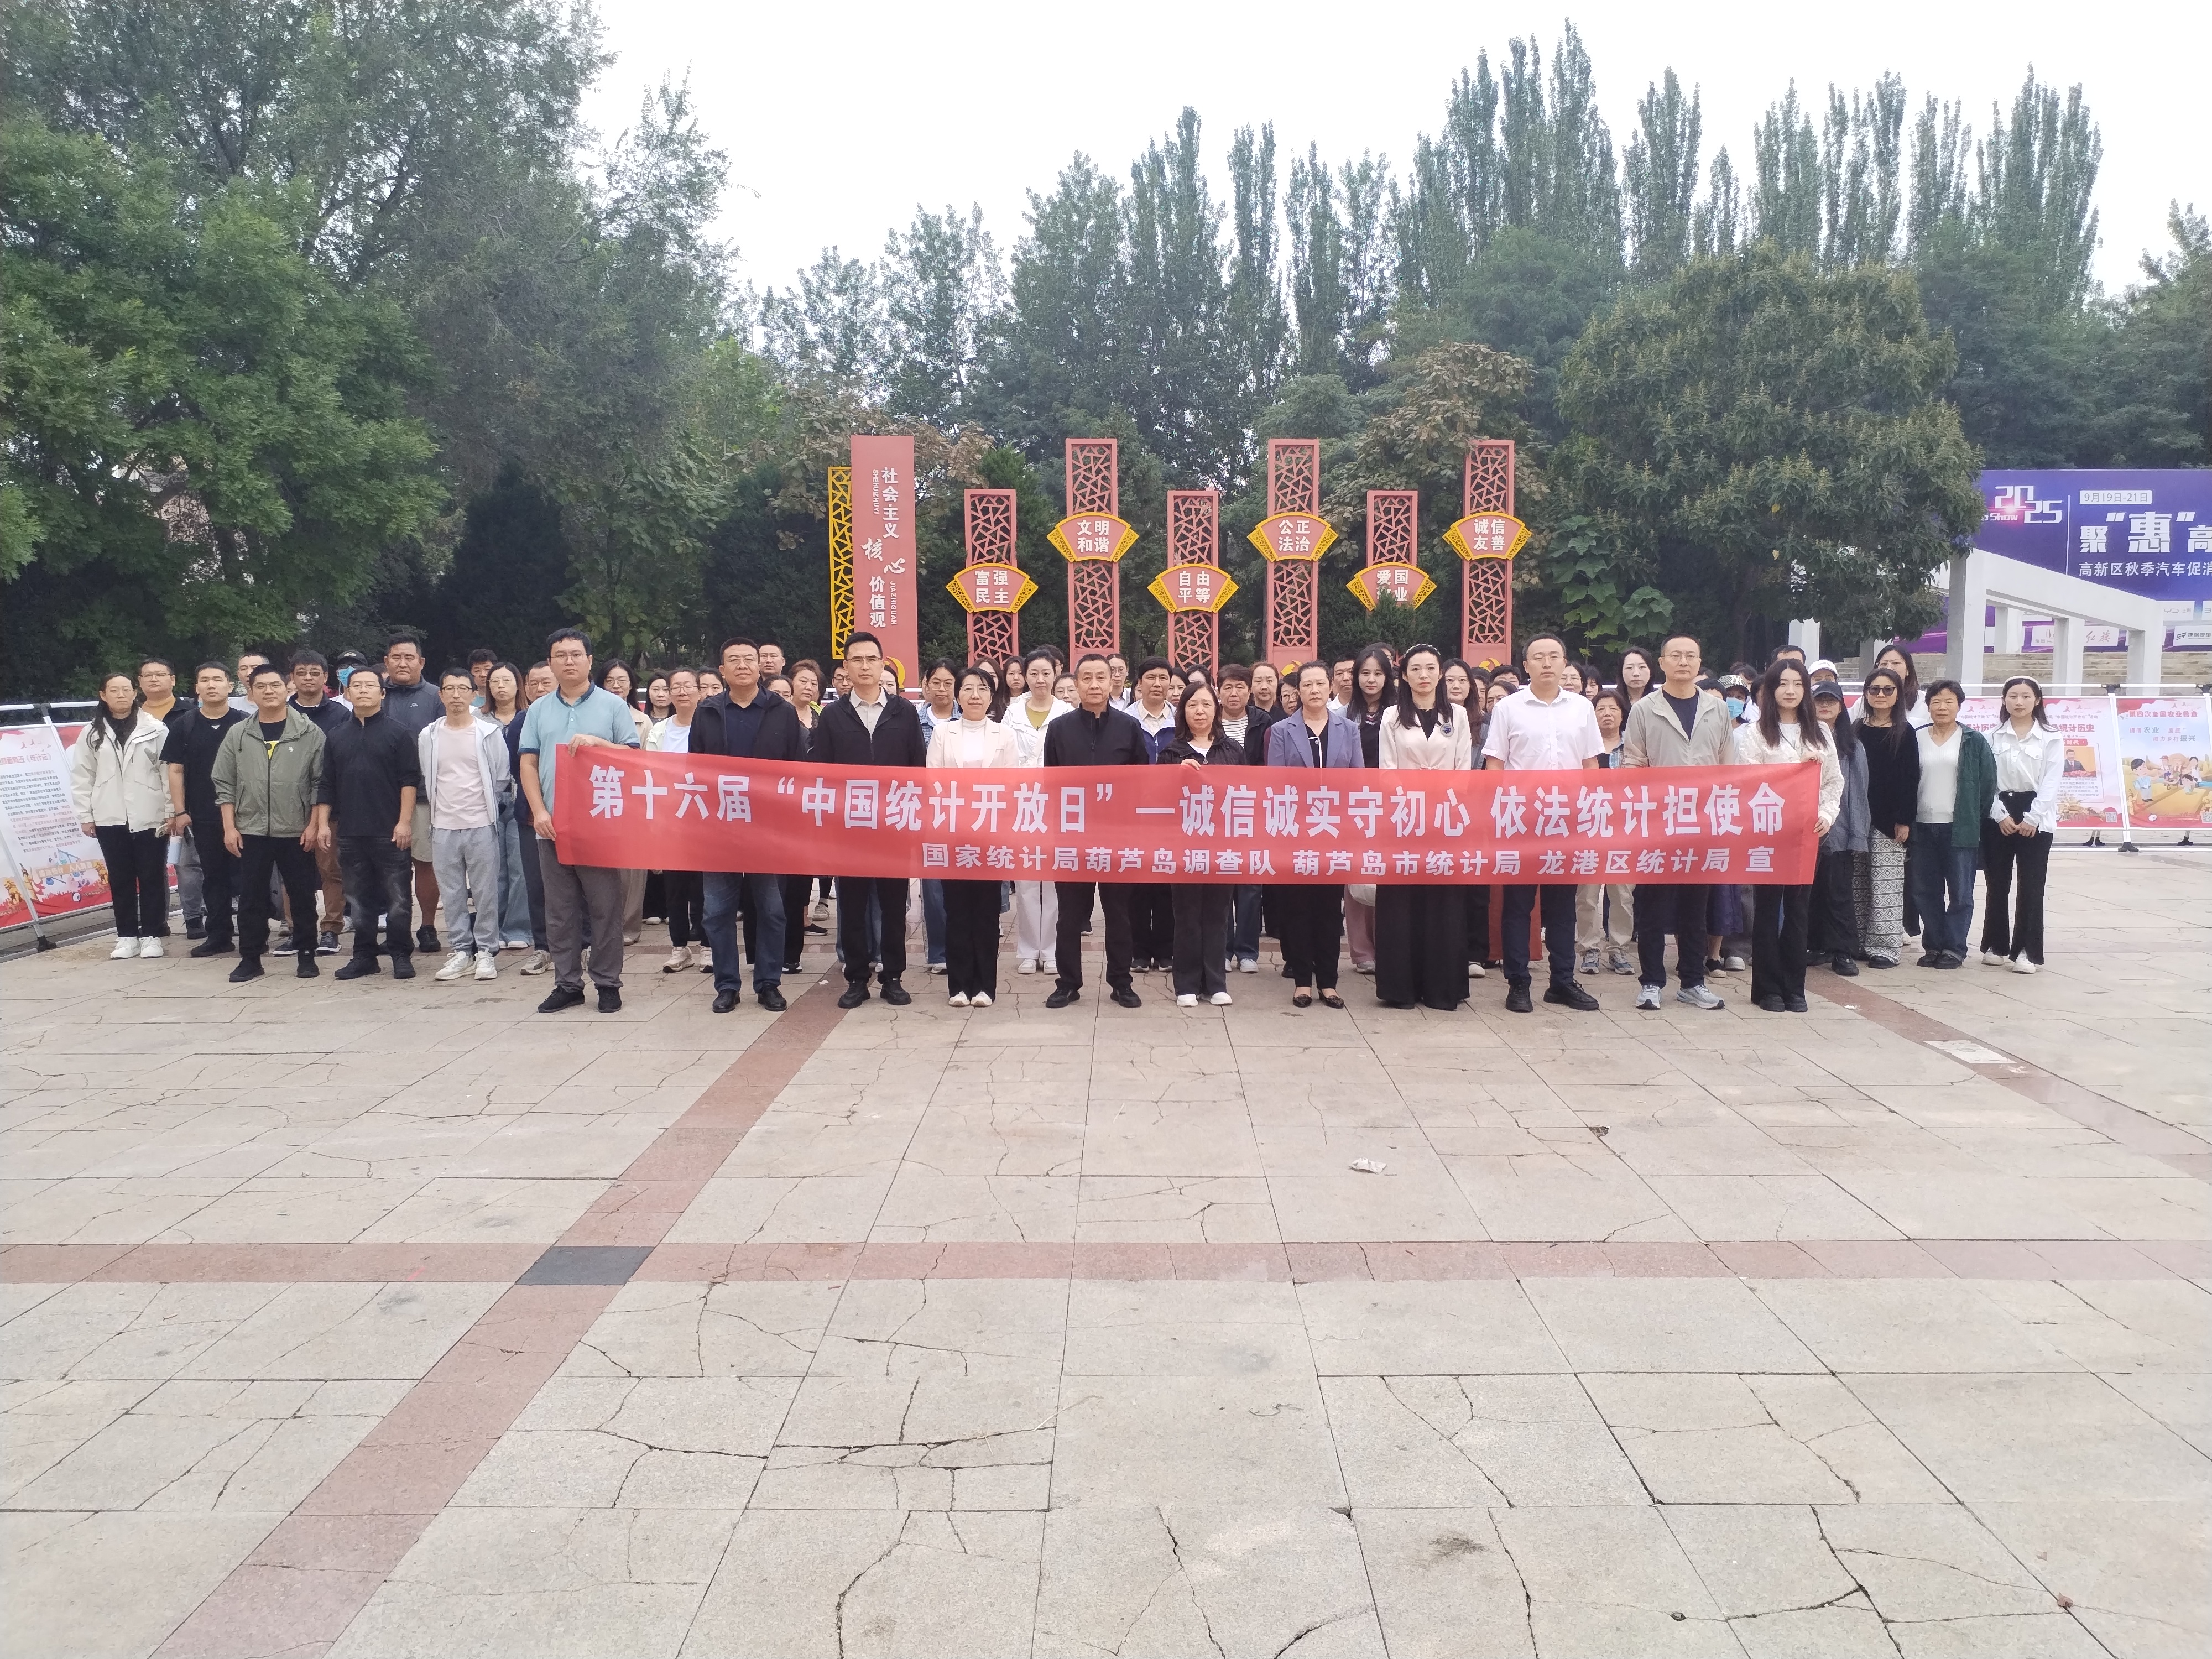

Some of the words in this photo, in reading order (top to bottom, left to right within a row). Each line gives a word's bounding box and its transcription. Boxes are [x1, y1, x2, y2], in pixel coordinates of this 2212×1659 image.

[881, 467, 899, 539] 社会主义
[2084, 493, 2148, 503] 9月19日-21日
[1077, 520, 1109, 535] 文明
[1279, 520, 1310, 535] 公正
[1474, 519, 1505, 535] 诚信
[1077, 536, 1110, 553] 和谐
[1279, 536, 1310, 552] 法治
[1474, 535, 1505, 551] 友善
[860, 538, 905, 573] 核心
[2079, 561, 2212, 576] 高新区秋季汽车促消
[974, 570, 1008, 586] 富强
[1179, 571, 1210, 587] 自由
[1376, 569, 1408, 585] 爱国
[869, 576, 886, 628] 价值观
[975, 588, 1009, 604] 民主
[1178, 588, 1211, 603] 平等
[2086, 630, 2111, 643] 红旗
[1490, 782, 1786, 839] 依法统计担使命
[922, 843, 1276, 875] 国家统计局葫芦岛调查队
[1292, 849, 1521, 876] 葫芦岛市统计局
[1537, 849, 1730, 876] 龙港区统计局
[1745, 846, 1775, 872] 宣
